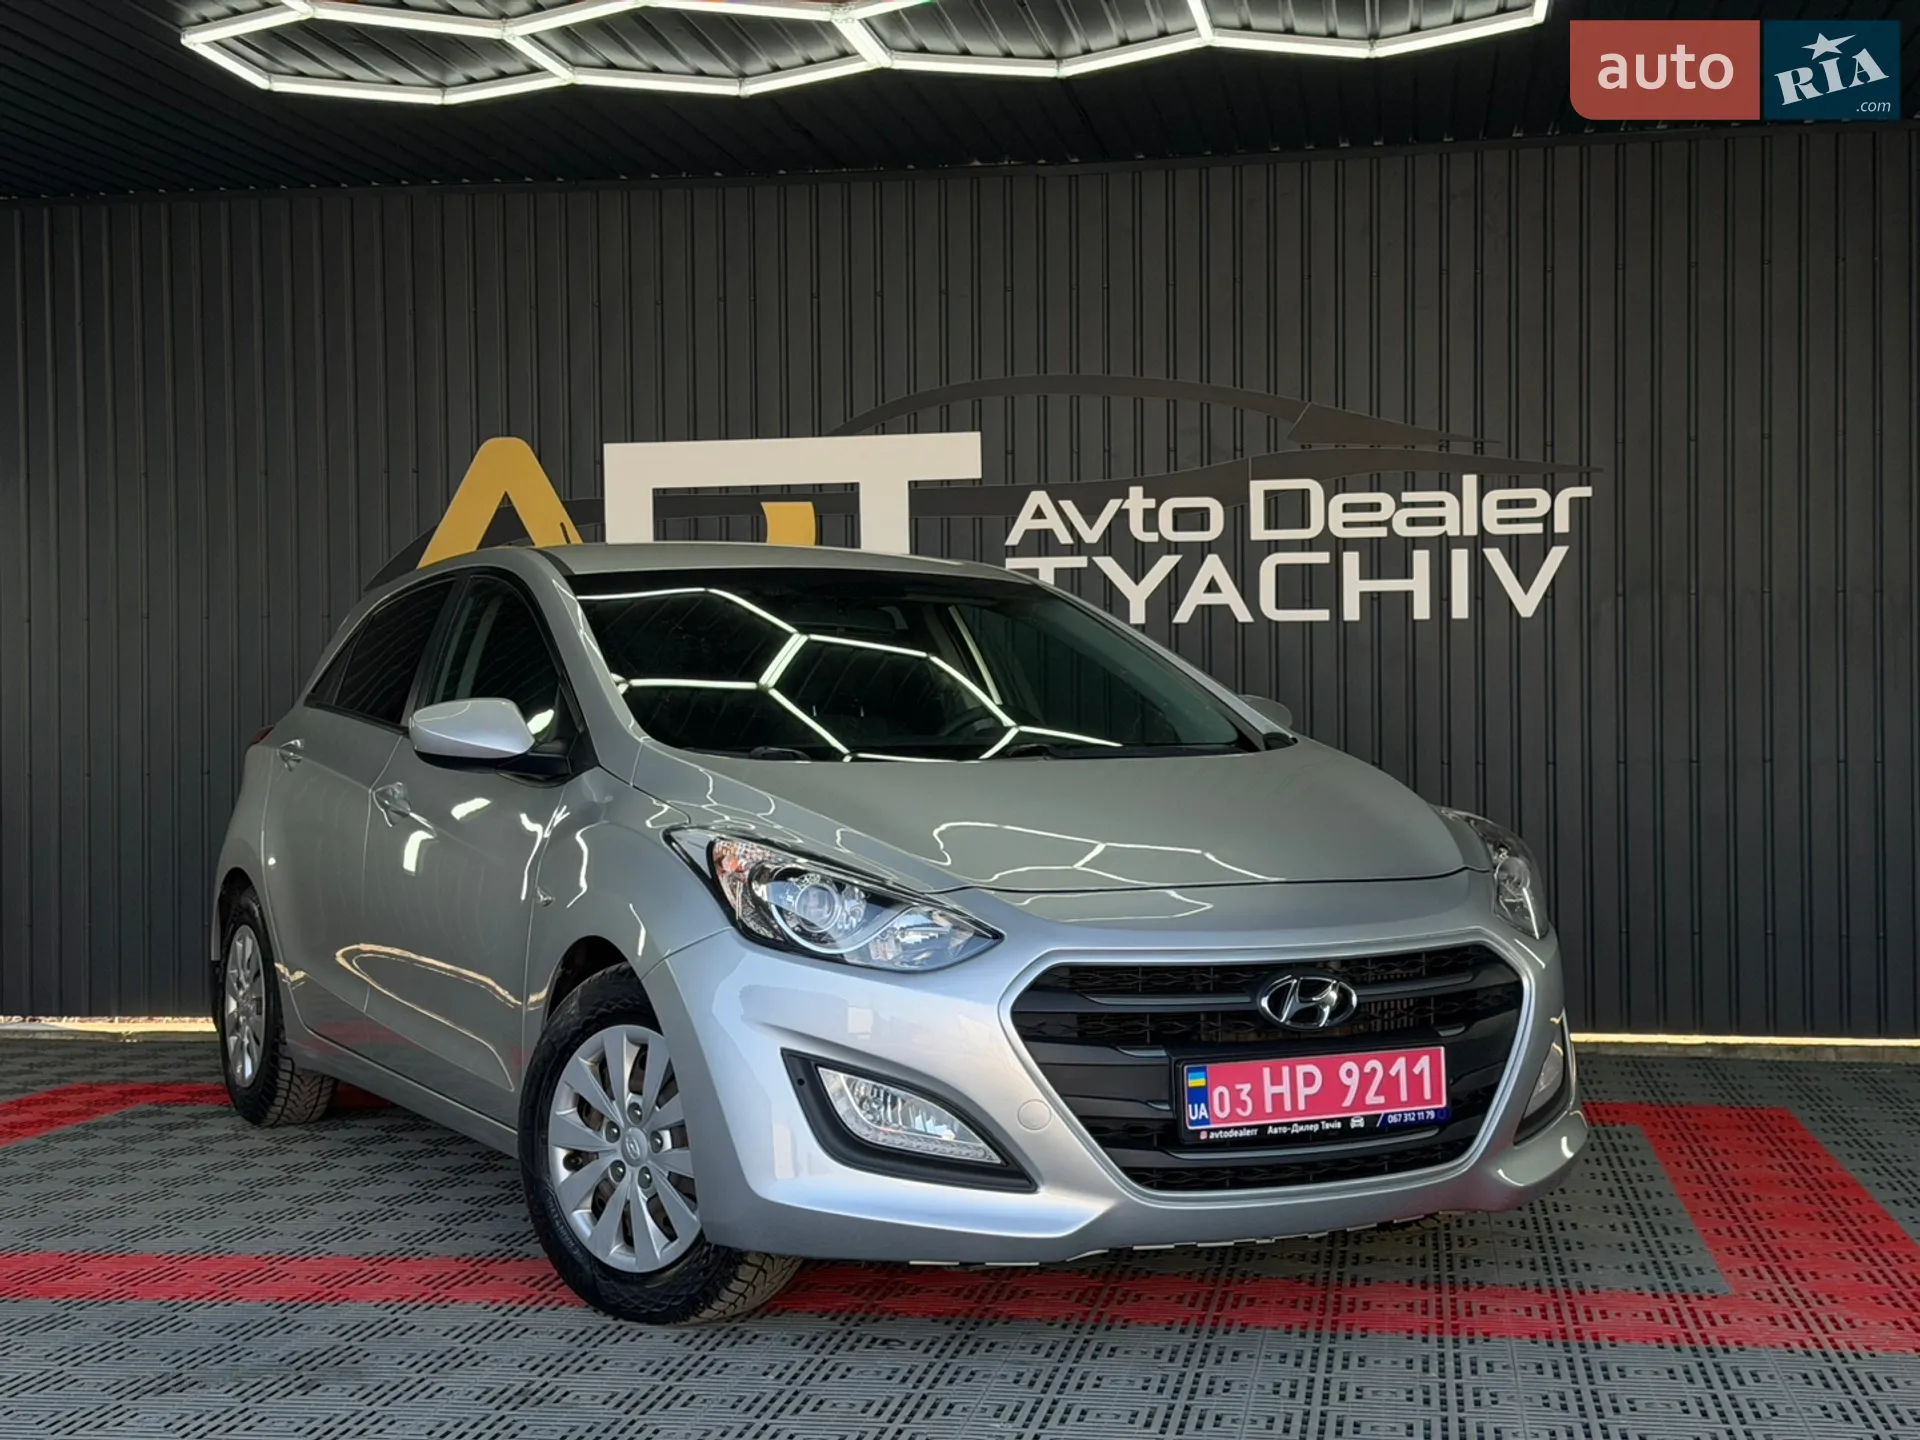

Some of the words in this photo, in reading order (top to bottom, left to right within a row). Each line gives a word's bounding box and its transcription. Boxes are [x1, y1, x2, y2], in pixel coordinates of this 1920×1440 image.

[1005, 486, 1224, 546] Avto
[1250, 474, 1592, 541] Dealer
[1213, 1083, 1253, 1119] 03
[1262, 1064, 1322, 1113] HP
[1339, 1055, 1432, 1107] 9211
[1188, 1103, 1209, 1121] UA
[1267, 1123, 1319, 1135] Авто-Дилер
